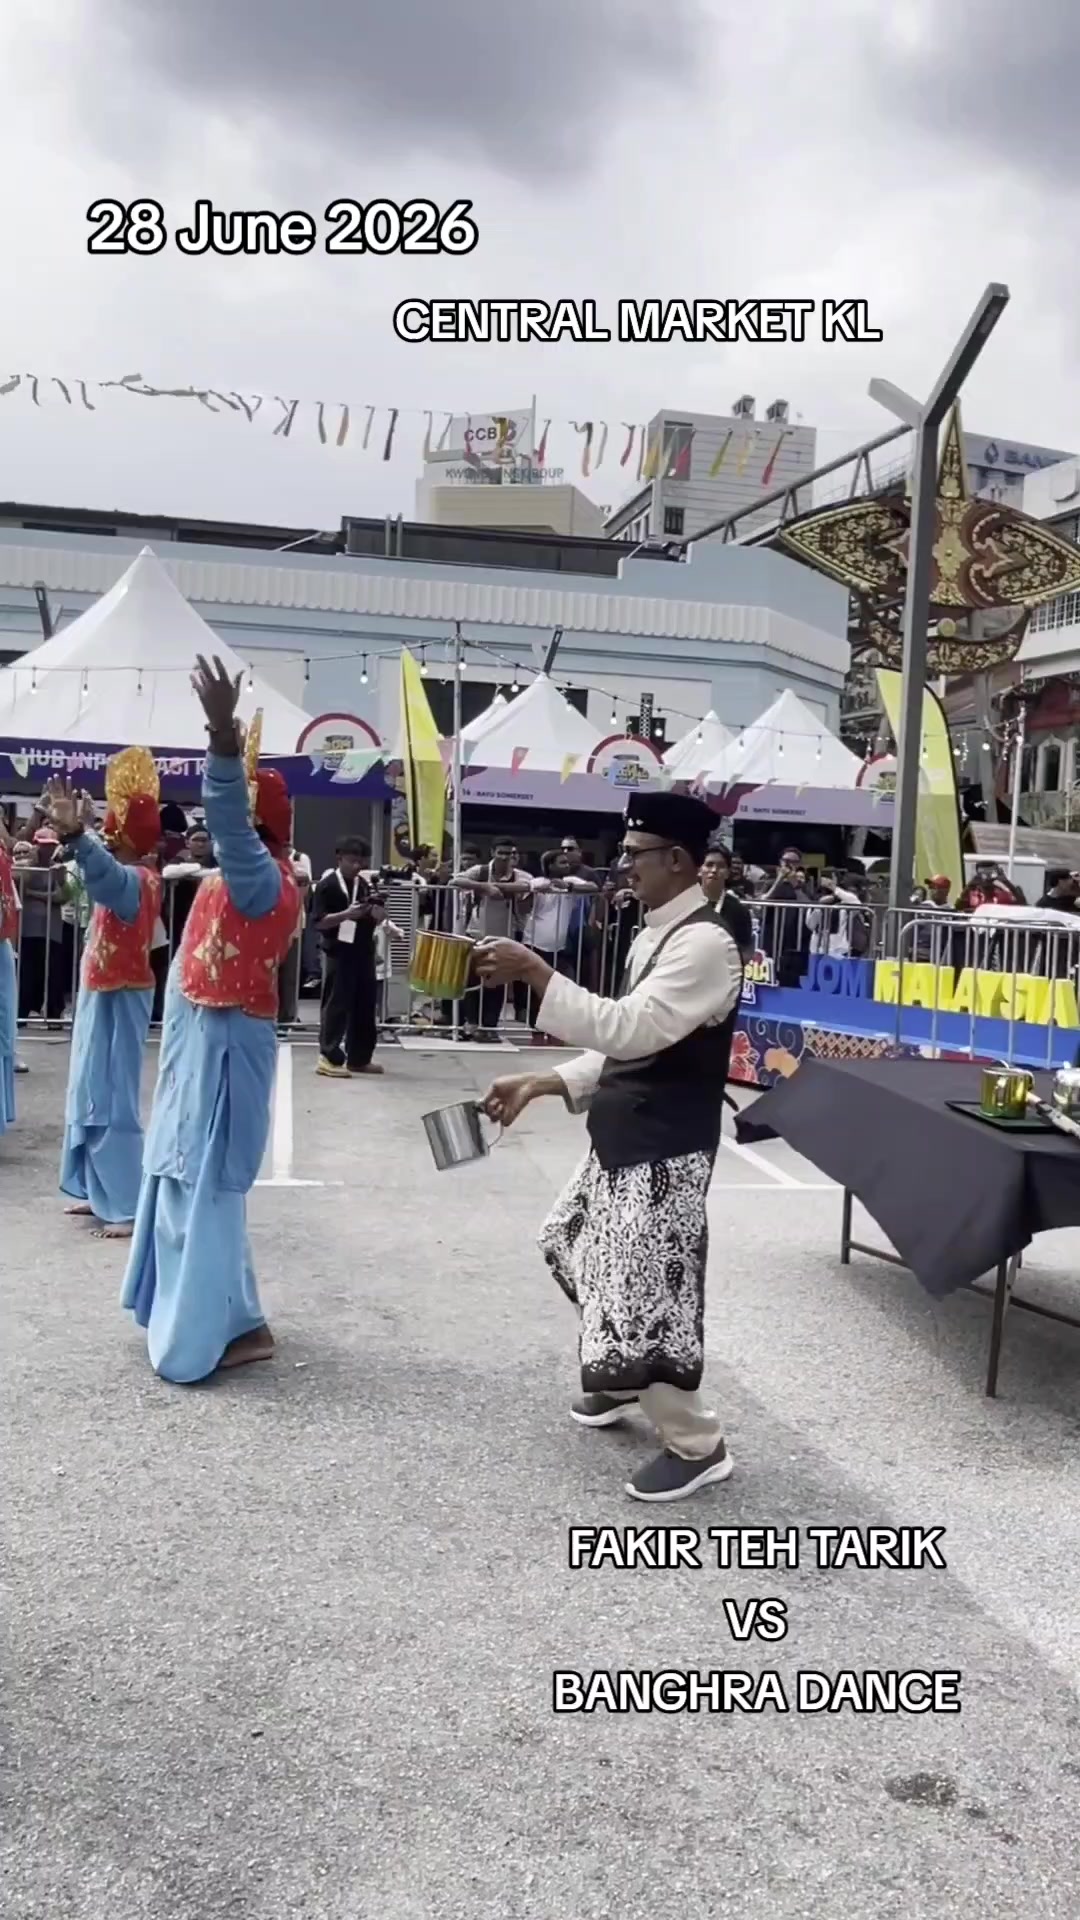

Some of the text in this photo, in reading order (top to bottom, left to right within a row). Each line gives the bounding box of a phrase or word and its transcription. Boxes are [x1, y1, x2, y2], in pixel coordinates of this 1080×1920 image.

[20, 747, 64, 769] HUB
[68, 752, 189, 776] INFASI
[800, 955, 867, 999] JOM
[873, 960, 1079, 1029] MALAYSIA
